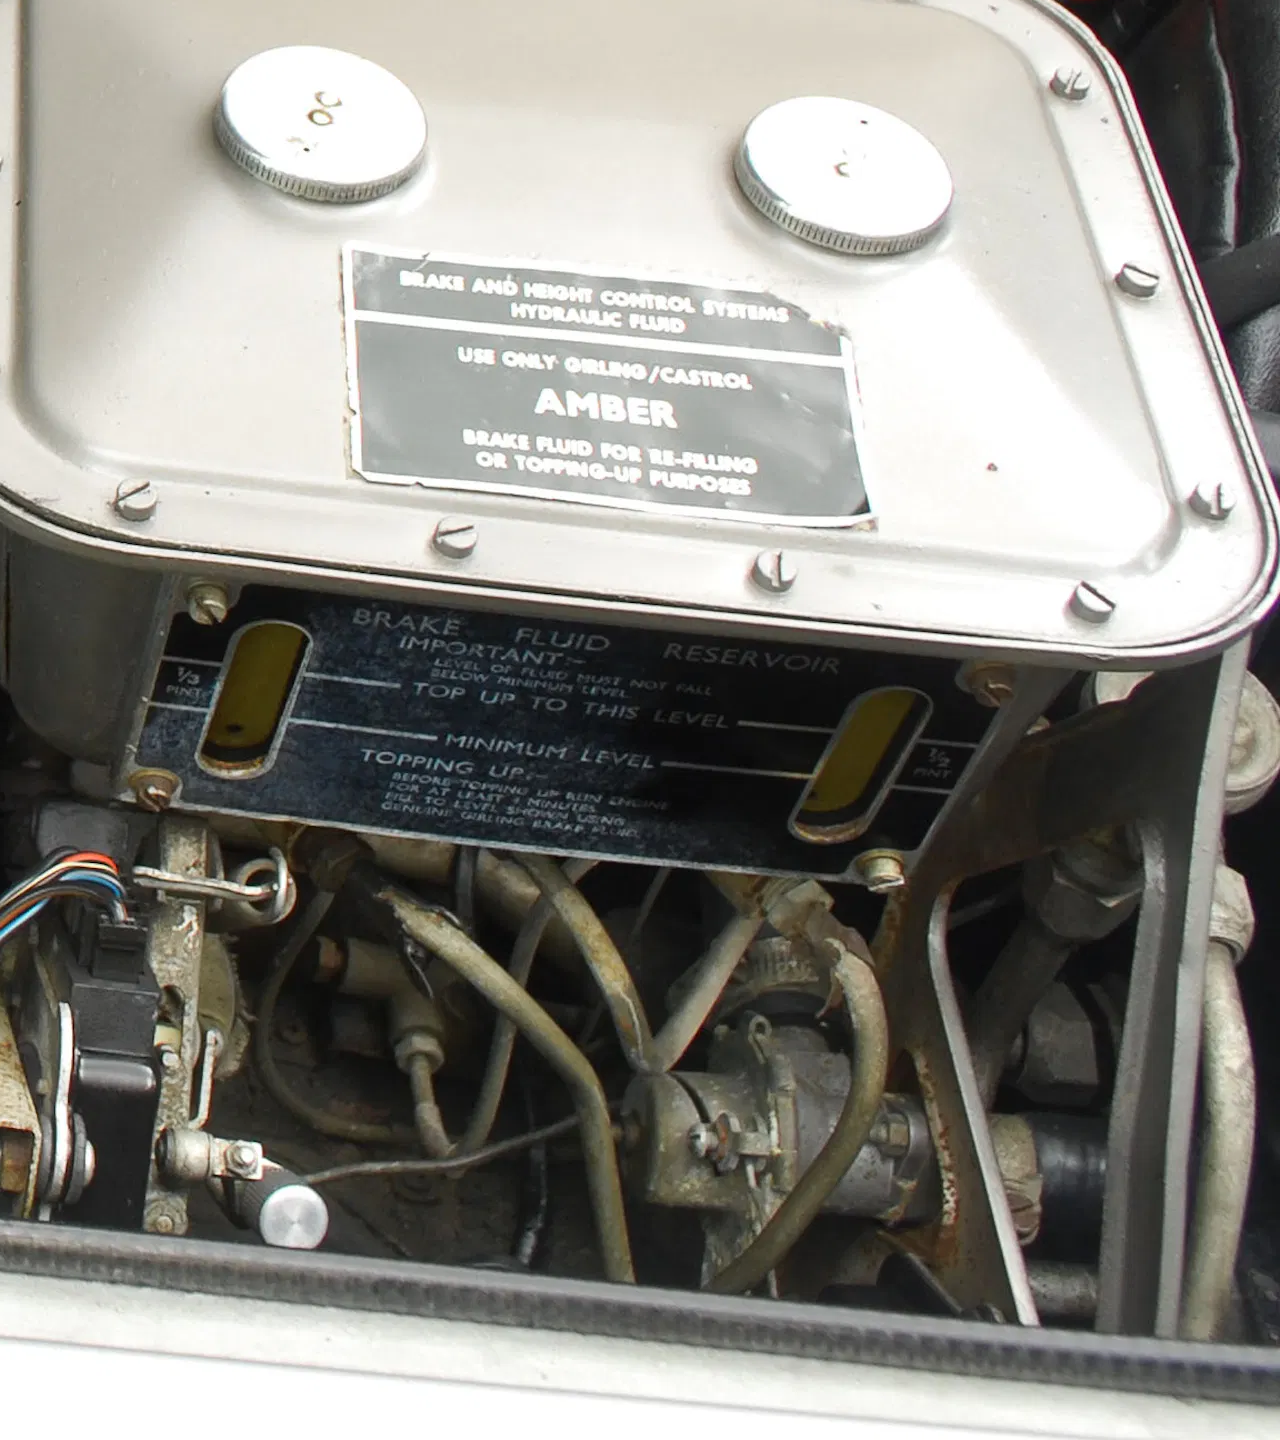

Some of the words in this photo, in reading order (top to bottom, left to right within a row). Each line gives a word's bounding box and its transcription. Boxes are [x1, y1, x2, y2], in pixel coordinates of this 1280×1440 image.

[399, 269, 465, 292] BRAKE
[472, 277, 519, 297] AND
[523, 282, 594, 304] HEIGHT
[600, 290, 696, 314] CONTROL
[702, 299, 791, 323] SYSTEMS
[510, 302, 623, 329] HYDRAULIC
[629, 313, 687, 334] FLUID
[457, 346, 497, 366] USE
[501, 349, 558, 371] ONLY
[533, 386, 679, 430] AMBER
[462, 428, 531, 452] BRAKE
[535, 436, 594, 458] FLUID
[600, 441, 642, 463] FOR
[648, 447, 759, 476] RE-FILLING
[475, 451, 508, 470] OR
[649, 469, 753, 497] PURPOSES
[352, 607, 466, 637] BRAKE
[514, 627, 611, 652] FLUID
[663, 641, 841, 675] RESERVOIR
[165, 683, 203, 699] PINT
[429, 667, 490, 684] BELOW
[496, 676, 575, 694] MINIMUM
[433, 658, 482, 672] LEVEL
[490, 663, 514, 675] OF
[520, 667, 569, 681] FLUID
[575, 672, 625, 687] MUST
[629, 678, 670, 692] NOT
[675, 682, 713, 697] FALL
[412, 682, 467, 700] TOP
[479, 689, 517, 706] UP
[529, 695, 569, 712] TO
[583, 701, 642, 720] THIS
[653, 710, 730, 730] LEVEL
[360, 748, 474, 775] TOPPING
[444, 733, 568, 761] MINIMUM
[579, 742, 656, 770] LEVEL
[389, 781, 420, 793] FOR
[428, 787, 452, 797] AT
[457, 790, 505, 803] LEAST
[527, 797, 597, 813] MINUTES
[391, 771, 452, 787] BEFORE
[460, 779, 529, 796] TOPPING
[565, 791, 604, 804] RUN
[380, 801, 453, 818] GENUINE
[384, 791, 414, 803] FILL
[424, 795, 447, 807] TO
[453, 800, 498, 813] LEVEL
[577, 813, 627, 827] USING
